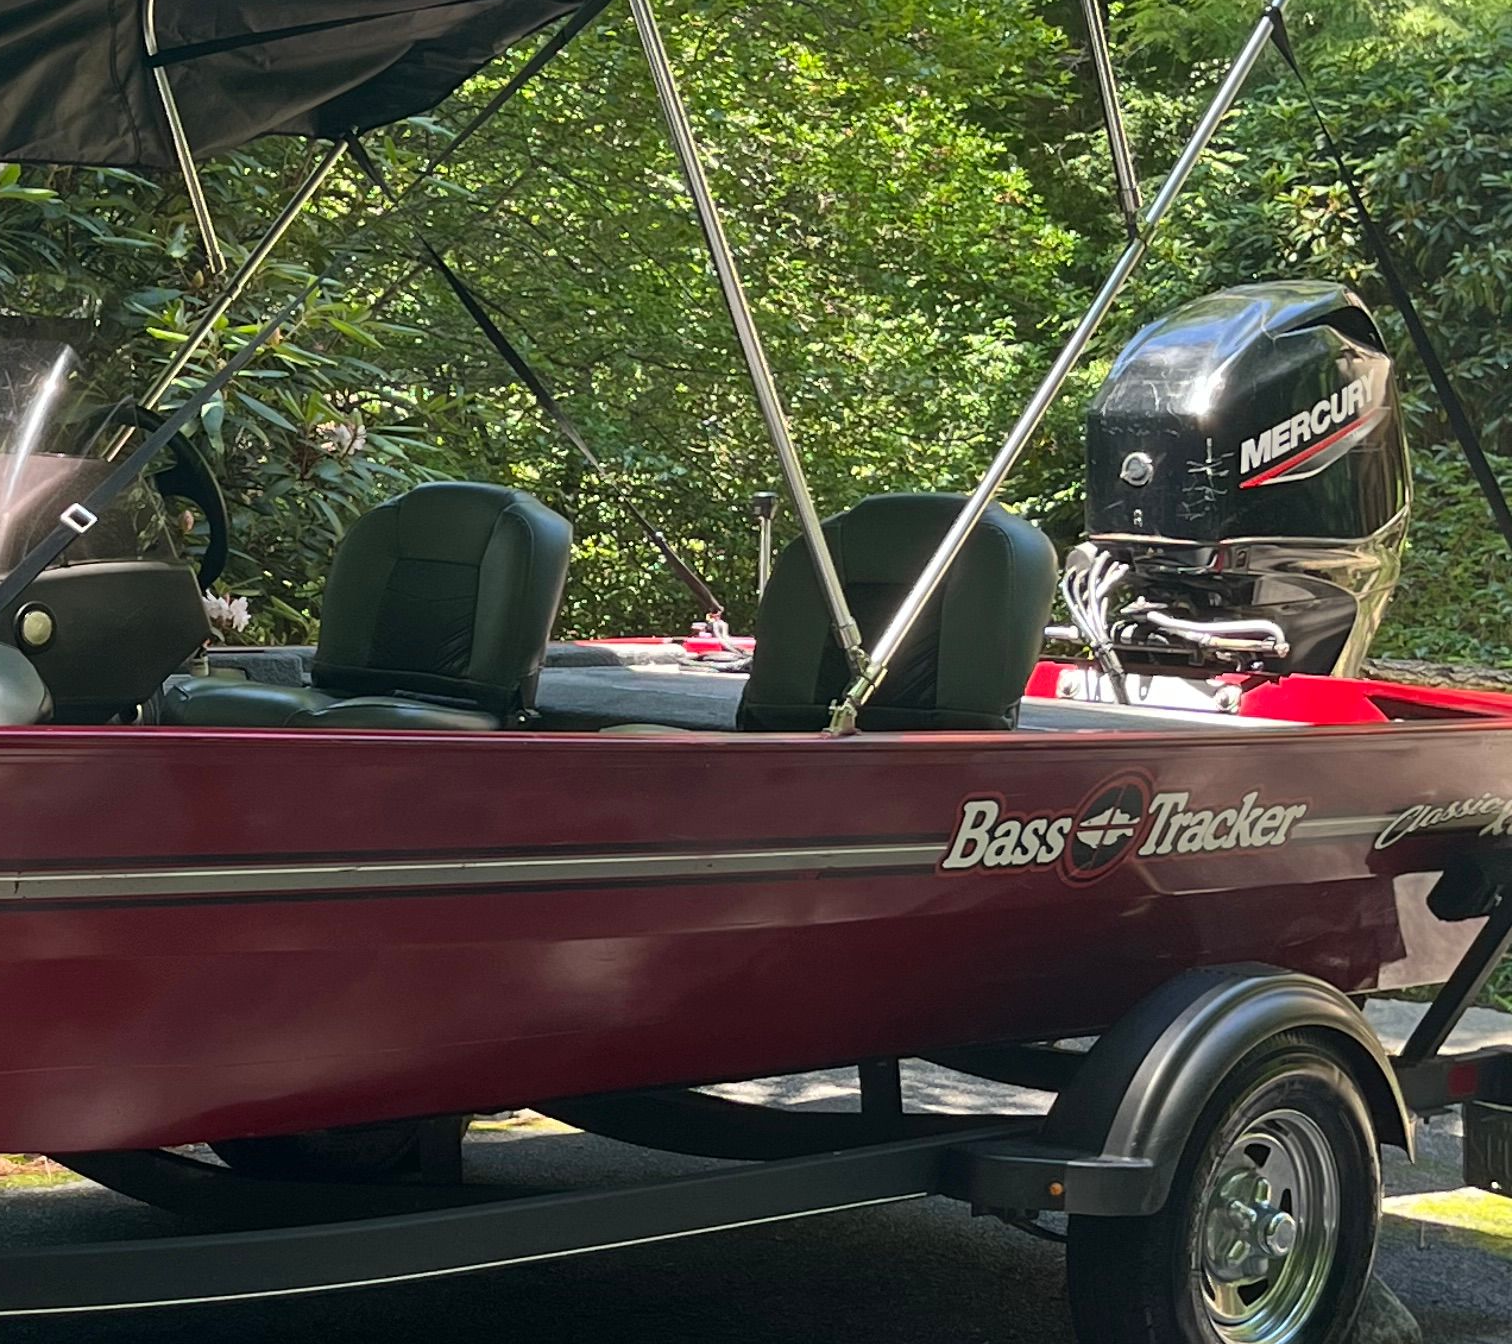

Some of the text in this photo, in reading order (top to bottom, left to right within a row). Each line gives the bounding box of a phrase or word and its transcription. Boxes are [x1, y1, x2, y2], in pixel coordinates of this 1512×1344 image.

[1240, 368, 1375, 475] MERCURY
[942, 791, 1307, 869] Bass Tracker
[1374, 792, 1504, 850] Classic
